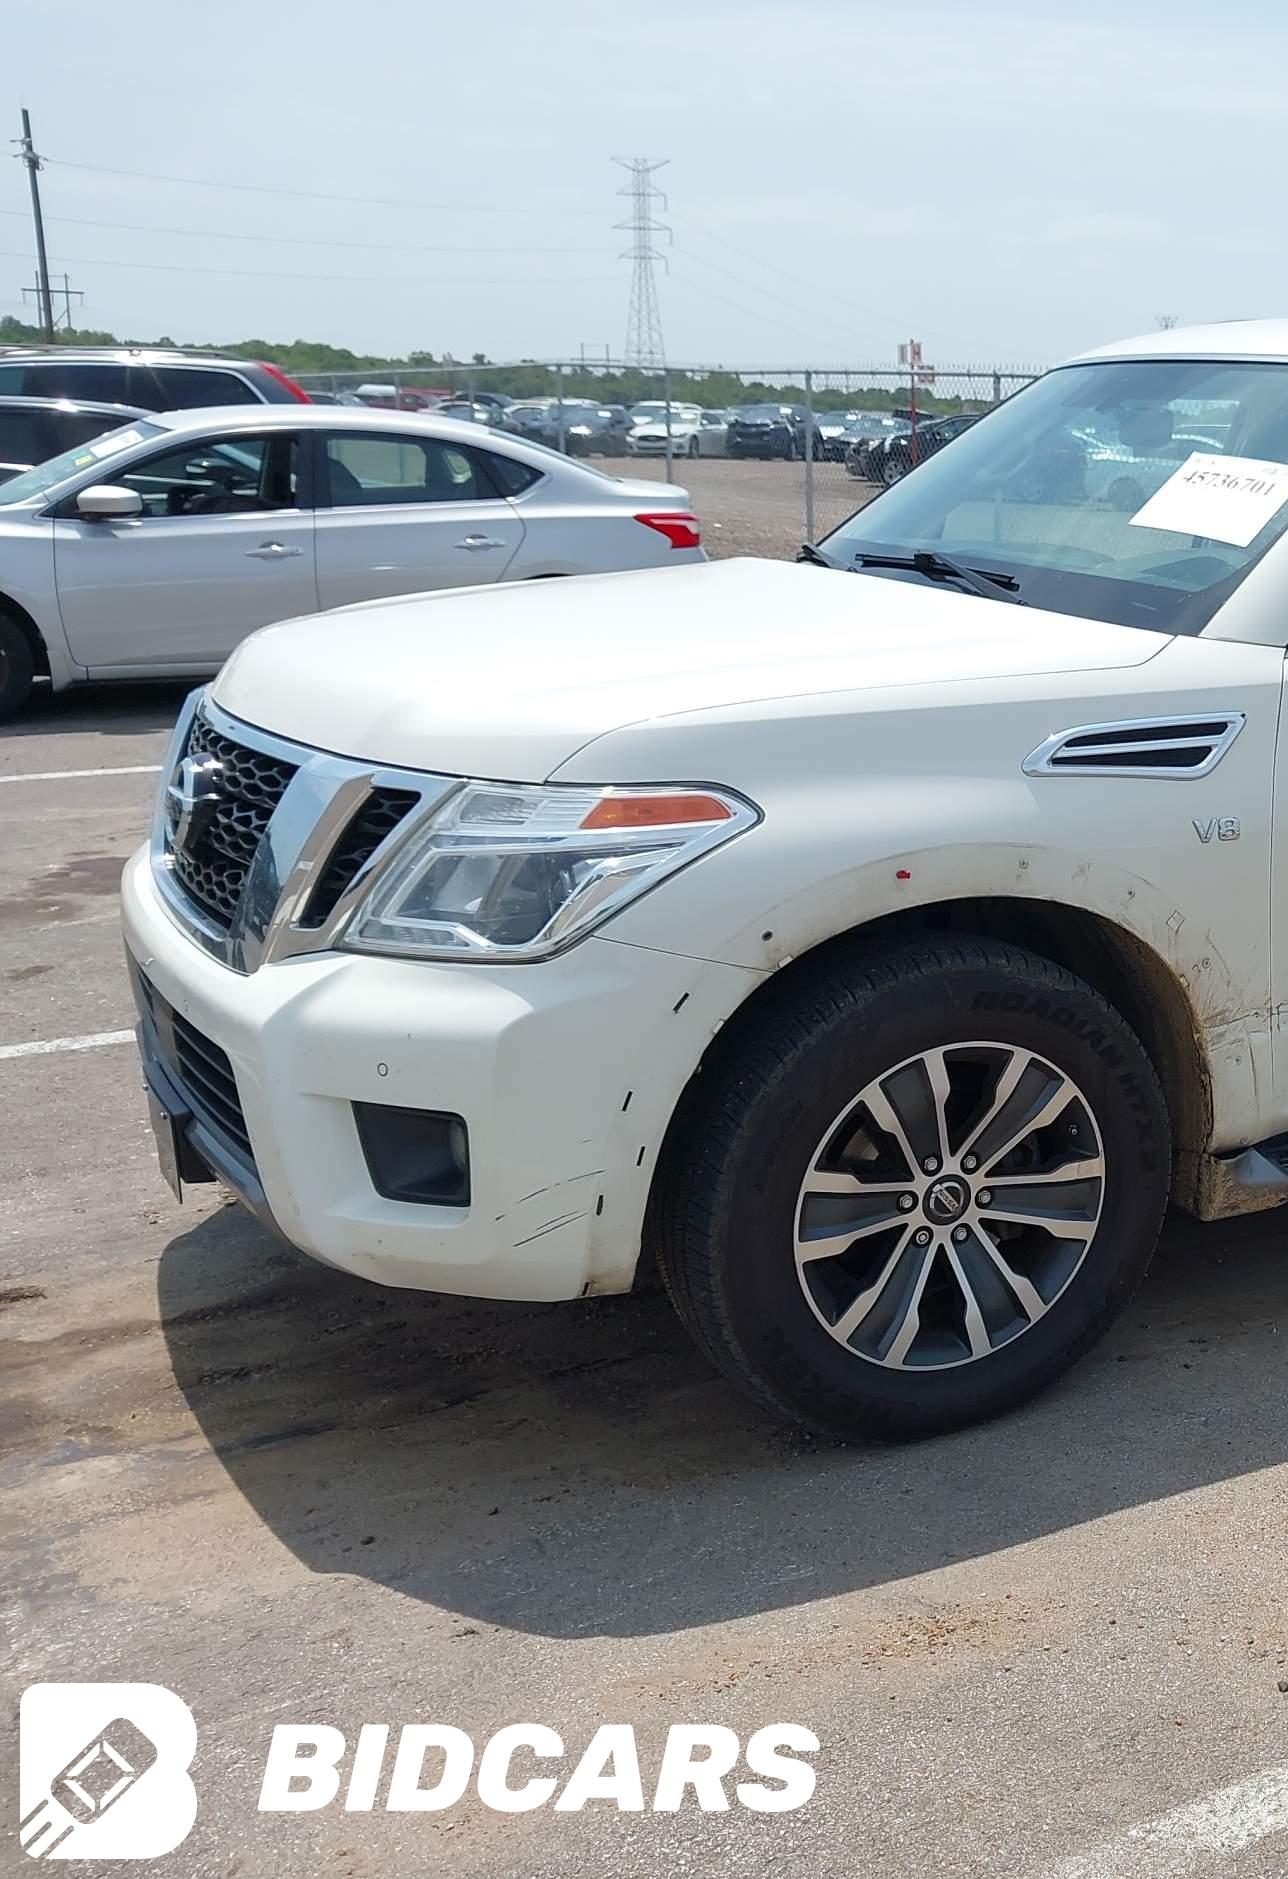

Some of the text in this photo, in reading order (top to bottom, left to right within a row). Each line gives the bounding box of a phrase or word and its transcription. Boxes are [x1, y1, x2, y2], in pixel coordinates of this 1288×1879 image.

[1183, 469, 1277, 496] 45736701
[1191, 816, 1241, 844] V8
[970, 991, 1124, 1068] ROADIAN
